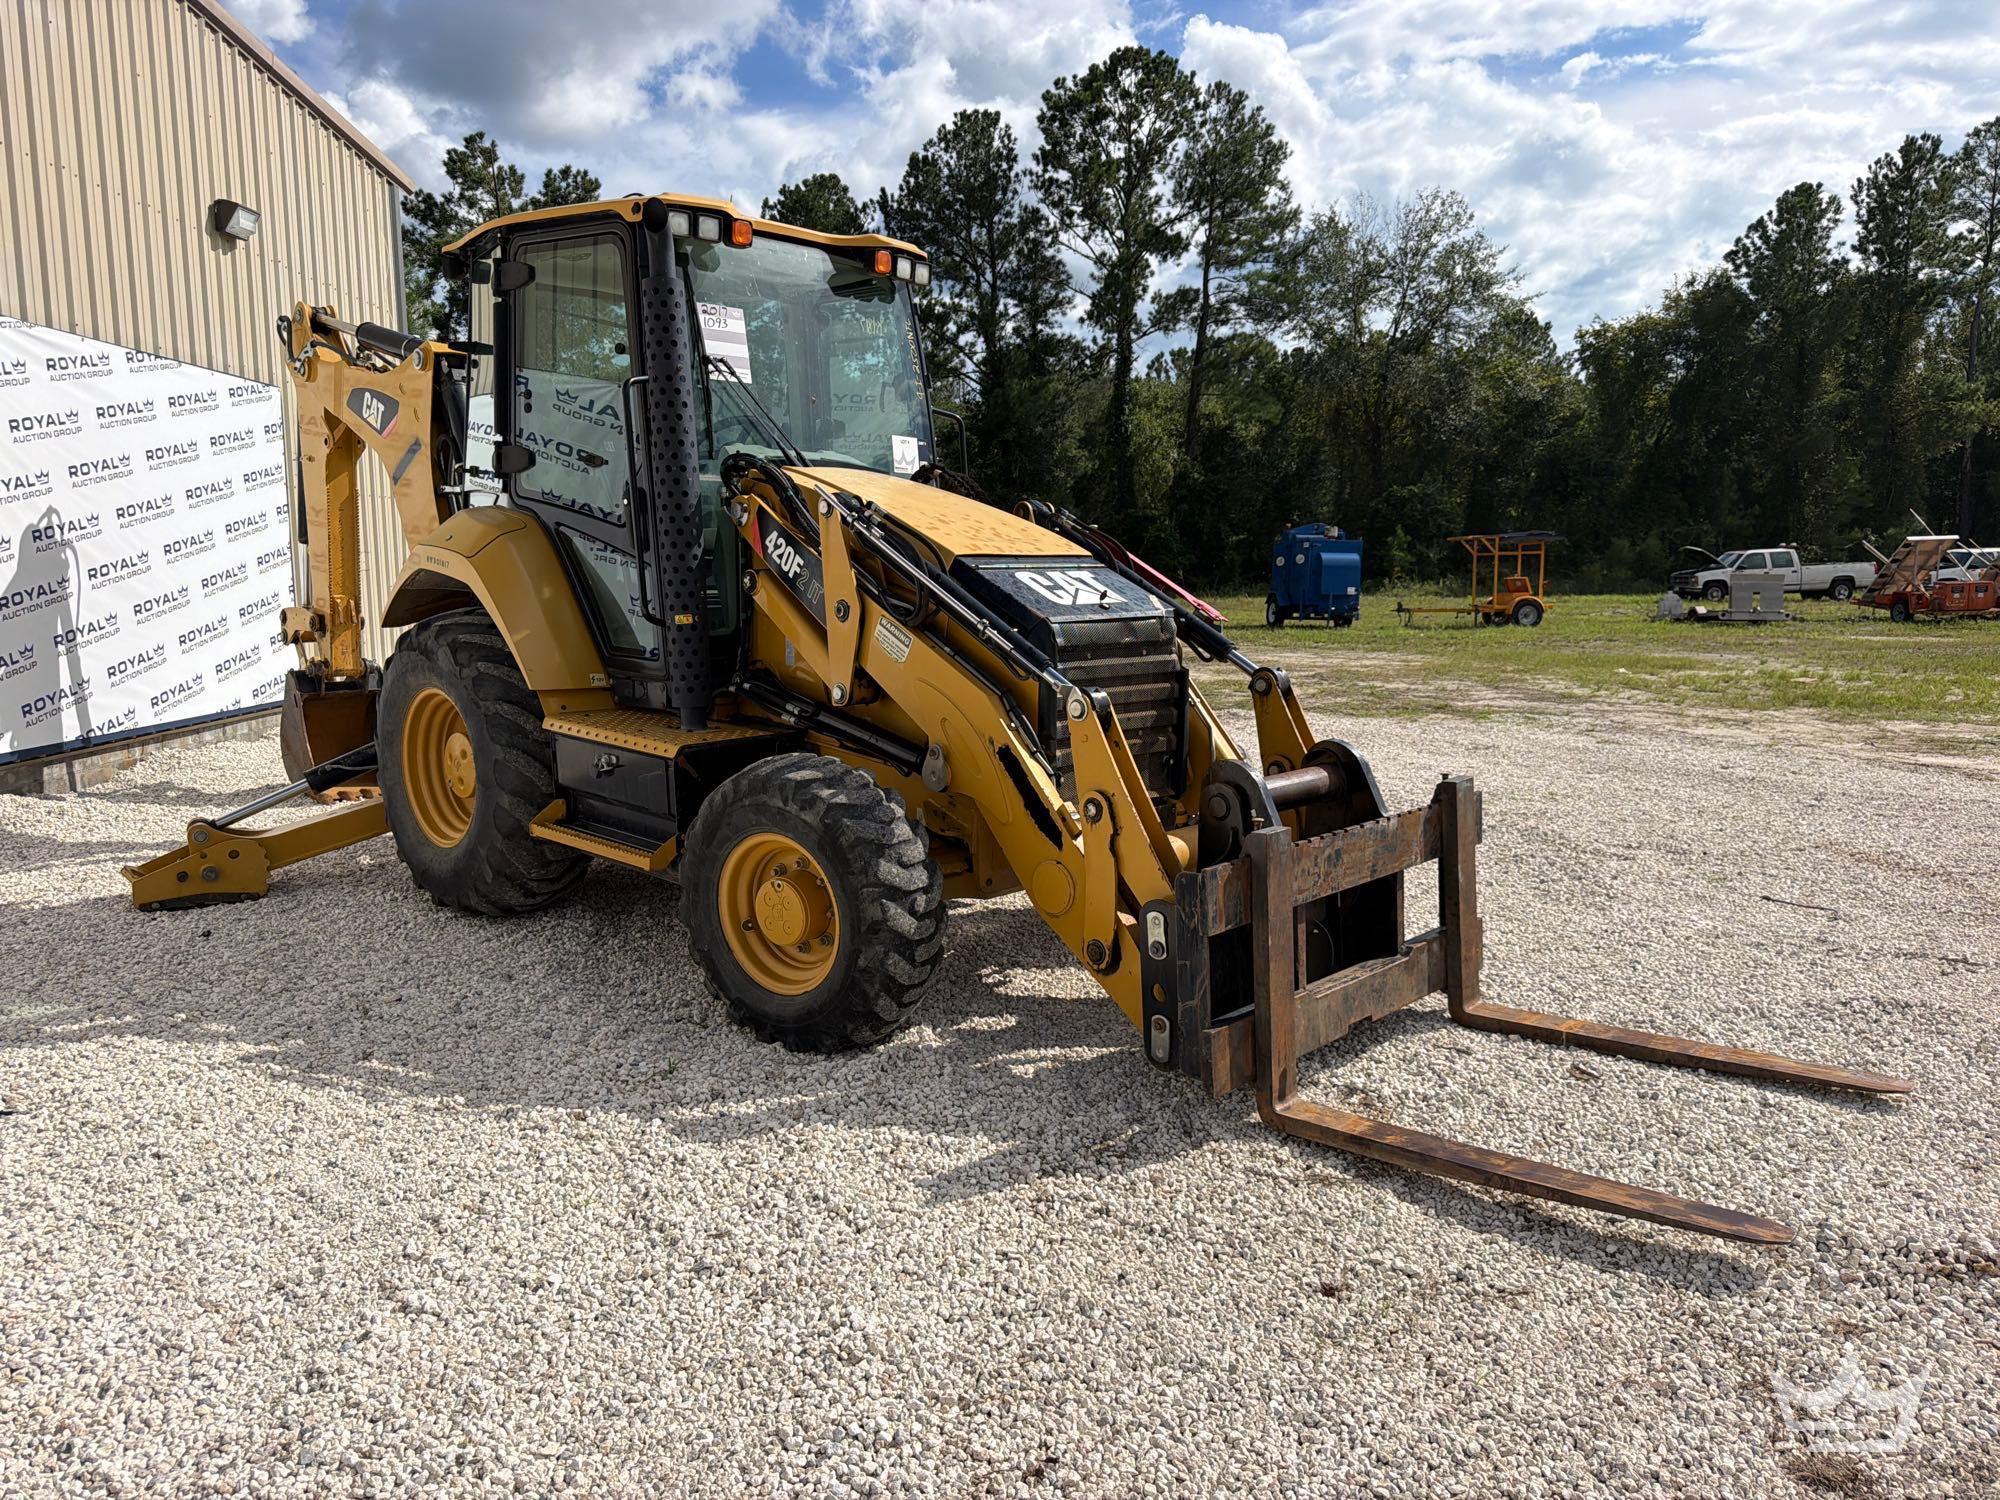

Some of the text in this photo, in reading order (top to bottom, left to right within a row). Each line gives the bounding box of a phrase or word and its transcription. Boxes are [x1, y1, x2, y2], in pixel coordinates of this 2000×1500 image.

[700, 304, 728, 316] 2017
[704, 317, 728, 328] 1093
[46, 354, 98, 372] ROYAL
[129, 364, 159, 374] AUCTION
[50, 368, 113, 382] AUCTION GROUP
[168, 392, 208, 408] ROYAL
[228, 384, 262, 398] ROYAL
[232, 395, 272, 407] AUCTION GROUP
[96, 402, 144, 419] ROYAL
[172, 404, 220, 418] AUCTION GROUP
[362, 392, 384, 430] CAT
[8, 413, 66, 433] ROYAL
[100, 414, 157, 430] AUCTION GROUP
[13, 426, 82, 444] AUCTION GROUP
[210, 430, 246, 448] ROYAL
[146, 443, 188, 462] ROYAL
[212, 442, 256, 456] AUCTION GROUP
[68, 458, 119, 478] ROYAL
[149, 454, 200, 470] AUCTION GROUP
[0, 474, 36, 492] YAL
[72, 469, 134, 488] AUCTION GROUP
[243, 466, 275, 484] ROYAL
[246, 476, 284, 492] AUCTION GROUP
[22, 486, 54, 500] GROUP
[186, 482, 224, 500] ROYAL
[188, 490, 234, 510] AUCTION GROUP
[116, 498, 162, 520] ROYAL
[120, 508, 175, 530] AUCTION GROUP
[32, 518, 87, 544] ROYAL
[225, 514, 258, 534] ROYAL
[228, 524, 268, 543] AUCTION GROUP
[36, 529, 102, 554] AUCTION GROUP
[164, 534, 204, 556] ROYAL
[166, 543, 216, 565] AUCTION GROUP
[256, 546, 288, 567] ROYAL
[88, 556, 138, 581] ROYAL
[92, 565, 152, 591] AUCTION GROUP
[202, 568, 238, 590] ROYAL
[259, 562, 280, 575] AUCTION
[204, 576, 248, 598] AUCTION GROUP
[1014, 570, 1128, 606] CAT
[2, 592, 73, 622] AUCTION GROUP
[134, 590, 178, 616] ROYAL
[136, 599, 190, 626] AUCTION GROUP
[239, 596, 272, 618] ROYAL
[241, 612, 264, 627] AUCTION
[54, 618, 106, 648] ROYAL
[57, 627, 120, 658] AUCTION GROUP
[178, 621, 218, 646] ROYAL
[181, 628, 230, 655] AUCTION GROUP
[880, 618, 911, 646] WARNING
[6, 660, 38, 679] GROUP
[107, 650, 154, 679] ROYAL
[110, 658, 168, 689] AUCTION GROUP
[215, 650, 252, 676] ROYAL
[218, 656, 262, 684] AUCTION GROUP
[150, 680, 193, 709] ROYAL
[252, 674, 285, 700] ROYAL
[21, 685, 78, 718] ROYAL
[25, 692, 94, 728] AUCTION GROUP
[154, 686, 206, 718] AUCTION GROUP
